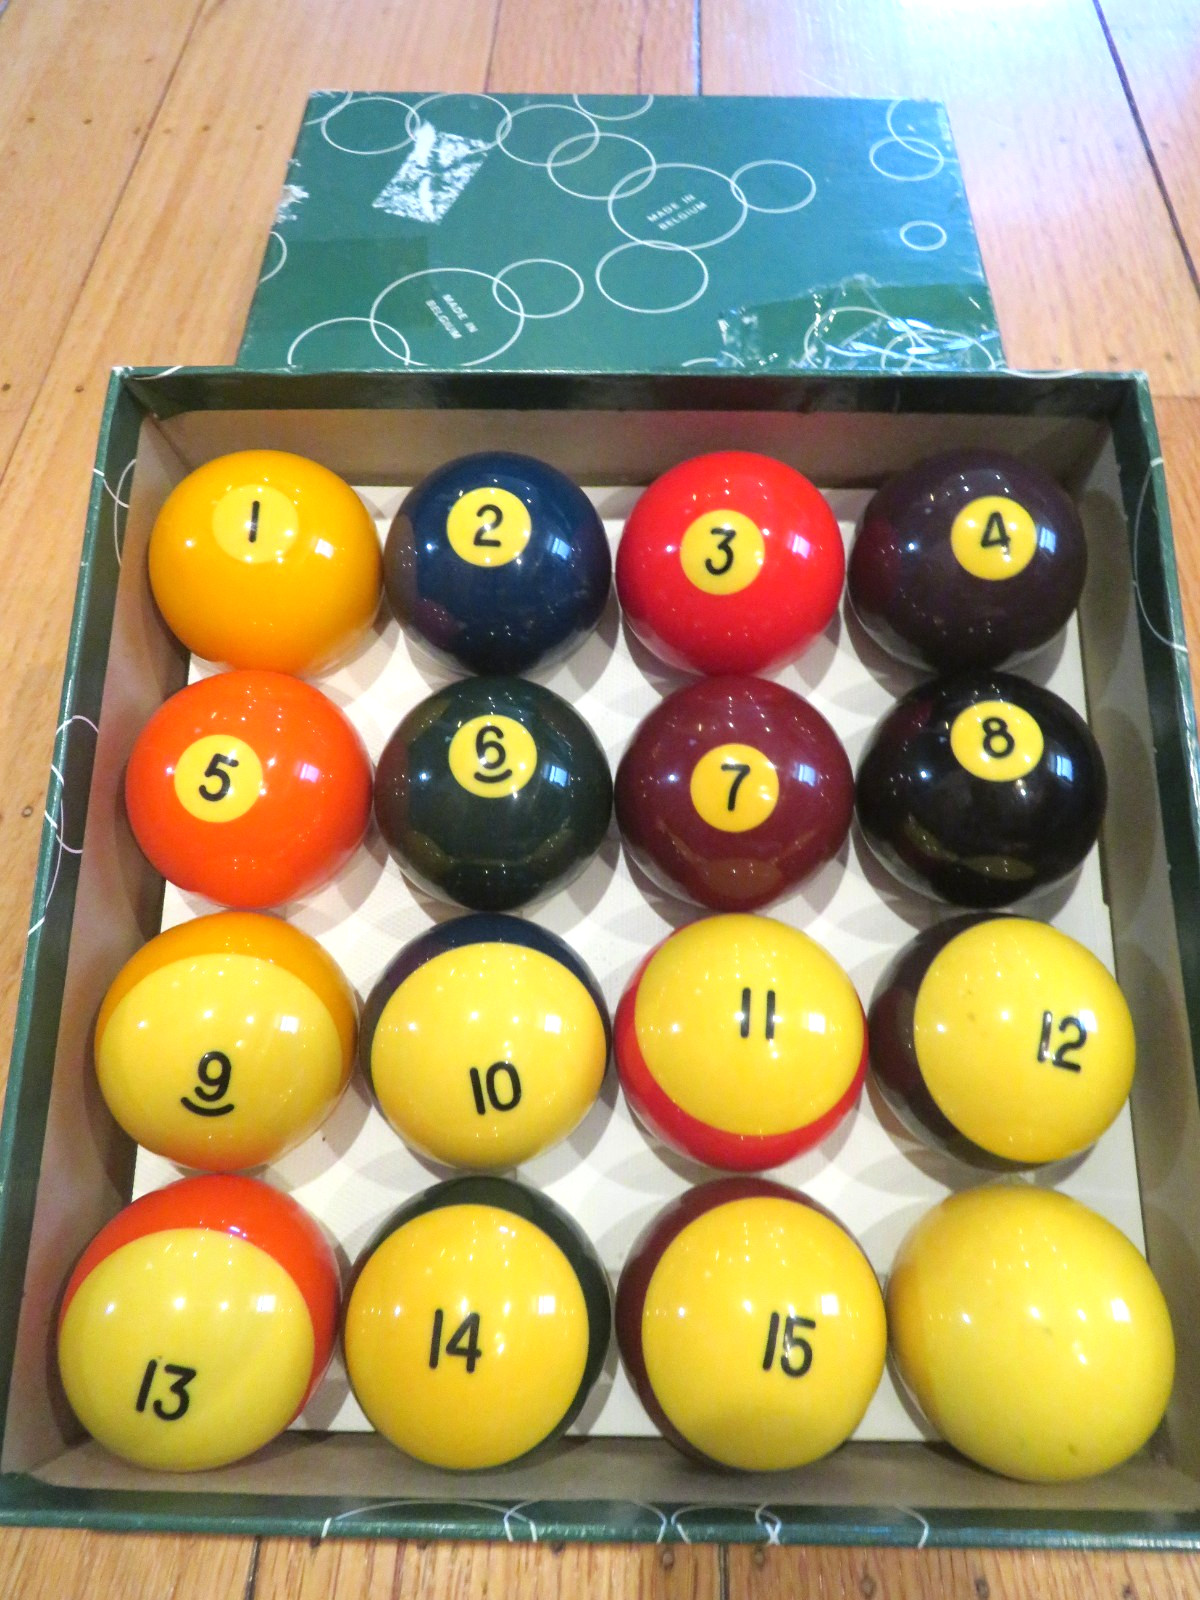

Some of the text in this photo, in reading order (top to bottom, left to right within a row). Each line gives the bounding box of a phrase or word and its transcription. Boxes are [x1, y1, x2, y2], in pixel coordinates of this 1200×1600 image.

[646, 193, 696, 222] MADE IN
[658, 200, 708, 231] BELGIUM
[442, 293, 469, 321] MADE
[248, 500, 260, 543] 1
[473, 503, 504, 548] 2
[980, 511, 1011, 554] 4
[704, 527, 737, 576] 3
[474, 725, 507, 770] 6
[982, 717, 1015, 759] 8
[198, 752, 239, 802] 5
[720, 763, 751, 811] 7
[739, 987, 776, 1040] 11
[1037, 1010, 1088, 1073] 12
[195, 1051, 232, 1103] 9
[469, 1060, 522, 1116] 10
[428, 1308, 483, 1374] 14
[762, 1311, 817, 1378] 15
[135, 1358, 198, 1422] 13
